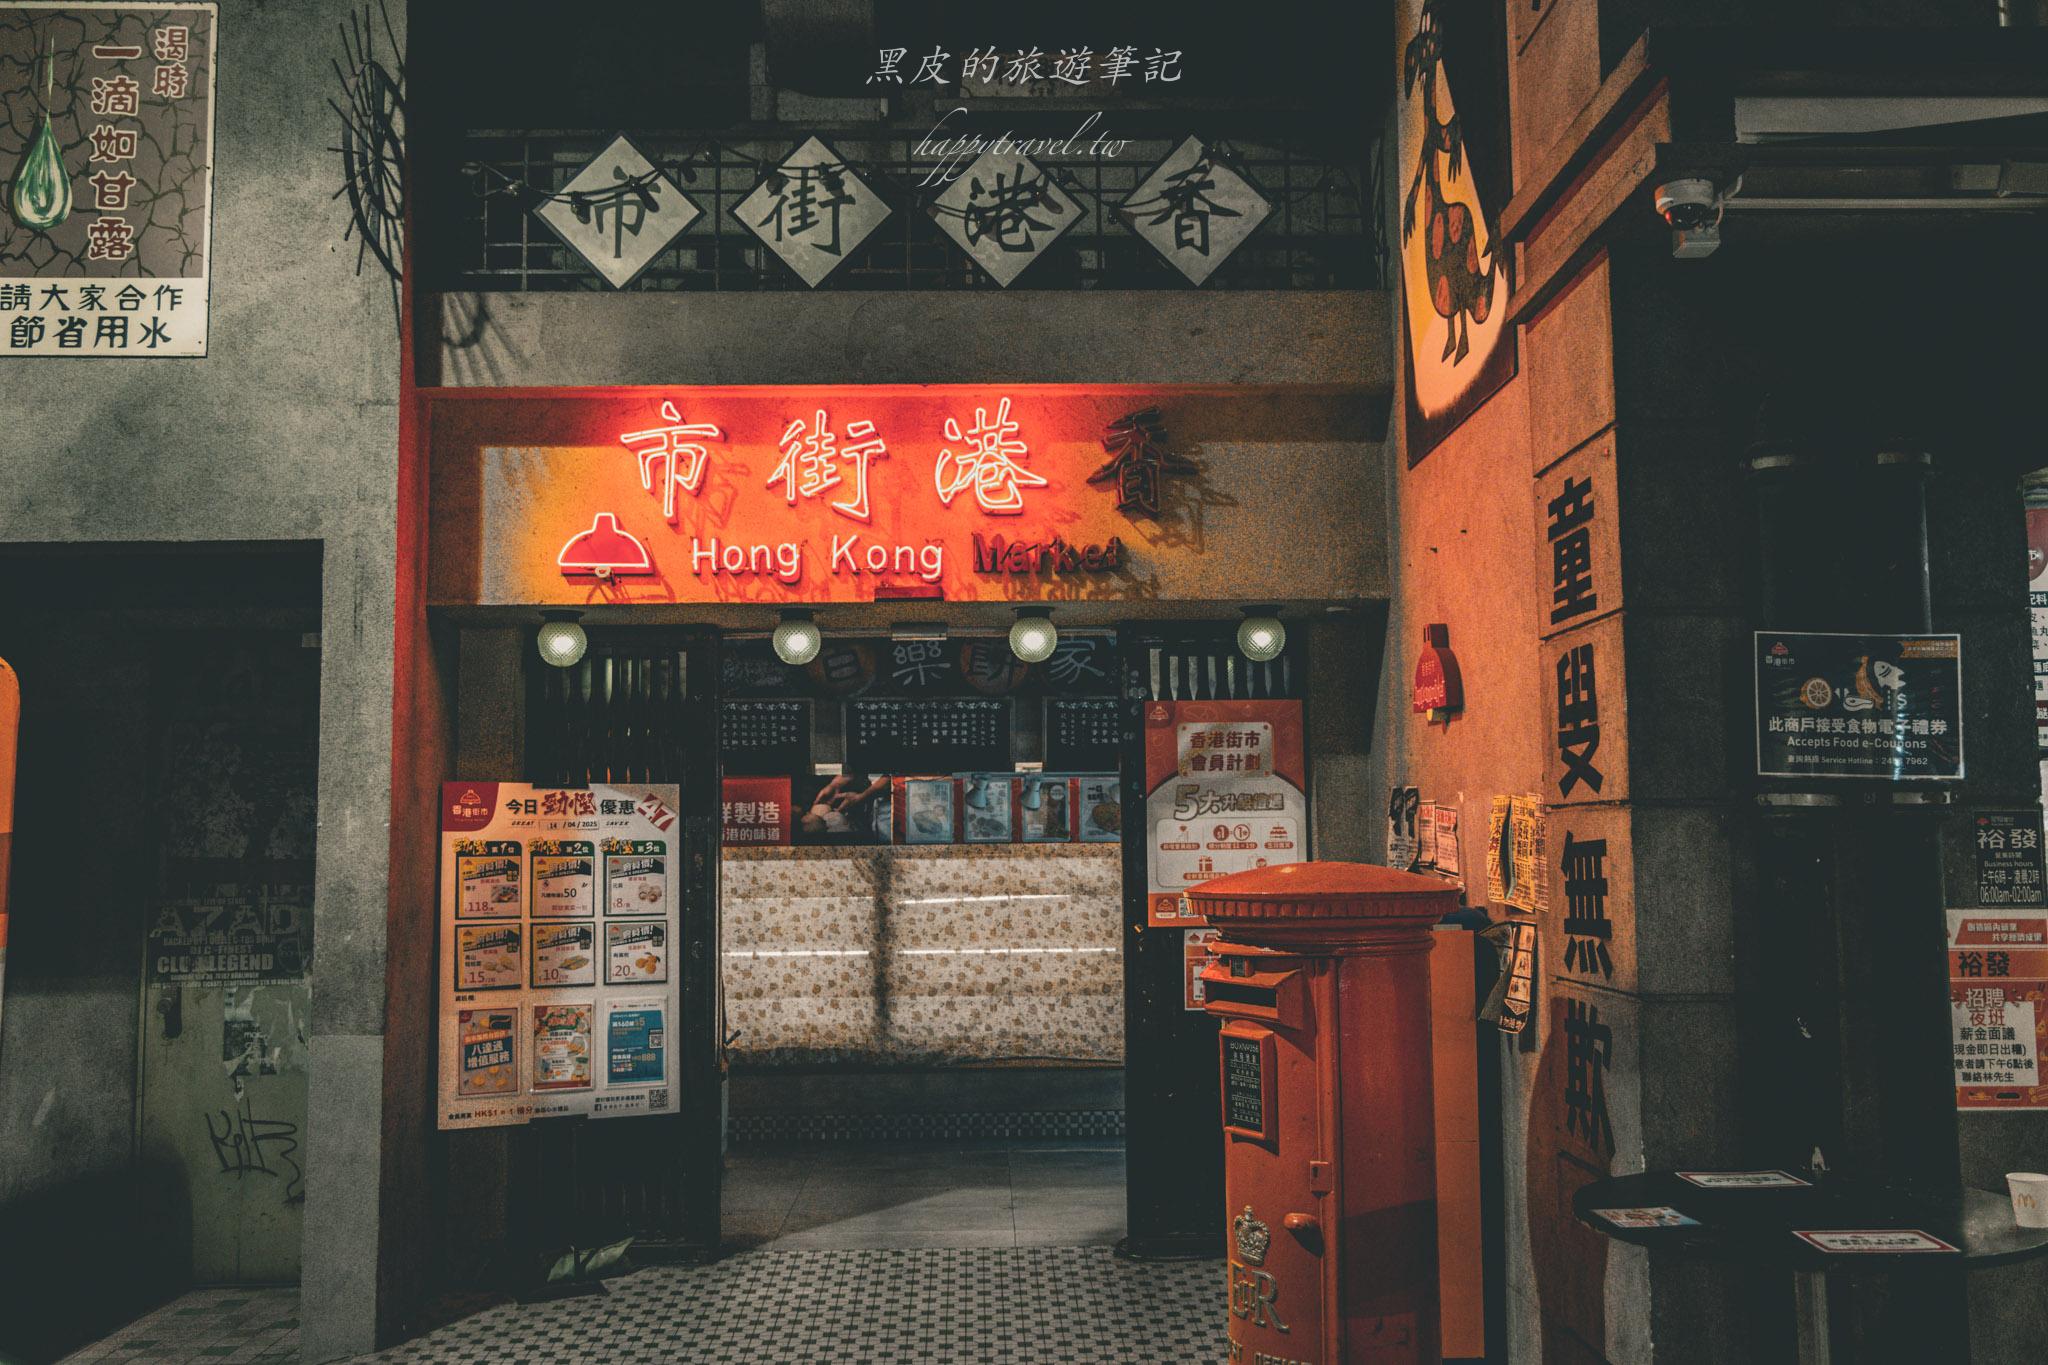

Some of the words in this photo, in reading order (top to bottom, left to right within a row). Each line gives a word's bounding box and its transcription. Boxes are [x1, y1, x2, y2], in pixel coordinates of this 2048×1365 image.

[154, 26, 189, 98] 渴時
[88, 45, 141, 261] 一滴如甘露
[0, 284, 184, 312] 請大家合作
[10, 316, 172, 349] 節省用水
[691, 536, 800, 579] Hong
[831, 534, 943, 580] Kong
[972, 531, 1124, 574] Market
[1190, 731, 1261, 748] 香港街市
[1787, 736, 1830, 748] Accepts
[1833, 737, 1859, 748] Food
[1862, 738, 1927, 749] e-Coupons
[1191, 754, 1261, 771] 會員計劃
[722, 828, 780, 840] 港的味道
[1977, 829, 2037, 849] 裕發
[1958, 951, 2010, 976] 裕發
[1965, 988, 2006, 1008] 招聘
[1969, 1008, 2006, 1026] 夜班
[1960, 1027, 2016, 1040] 薪金面議
